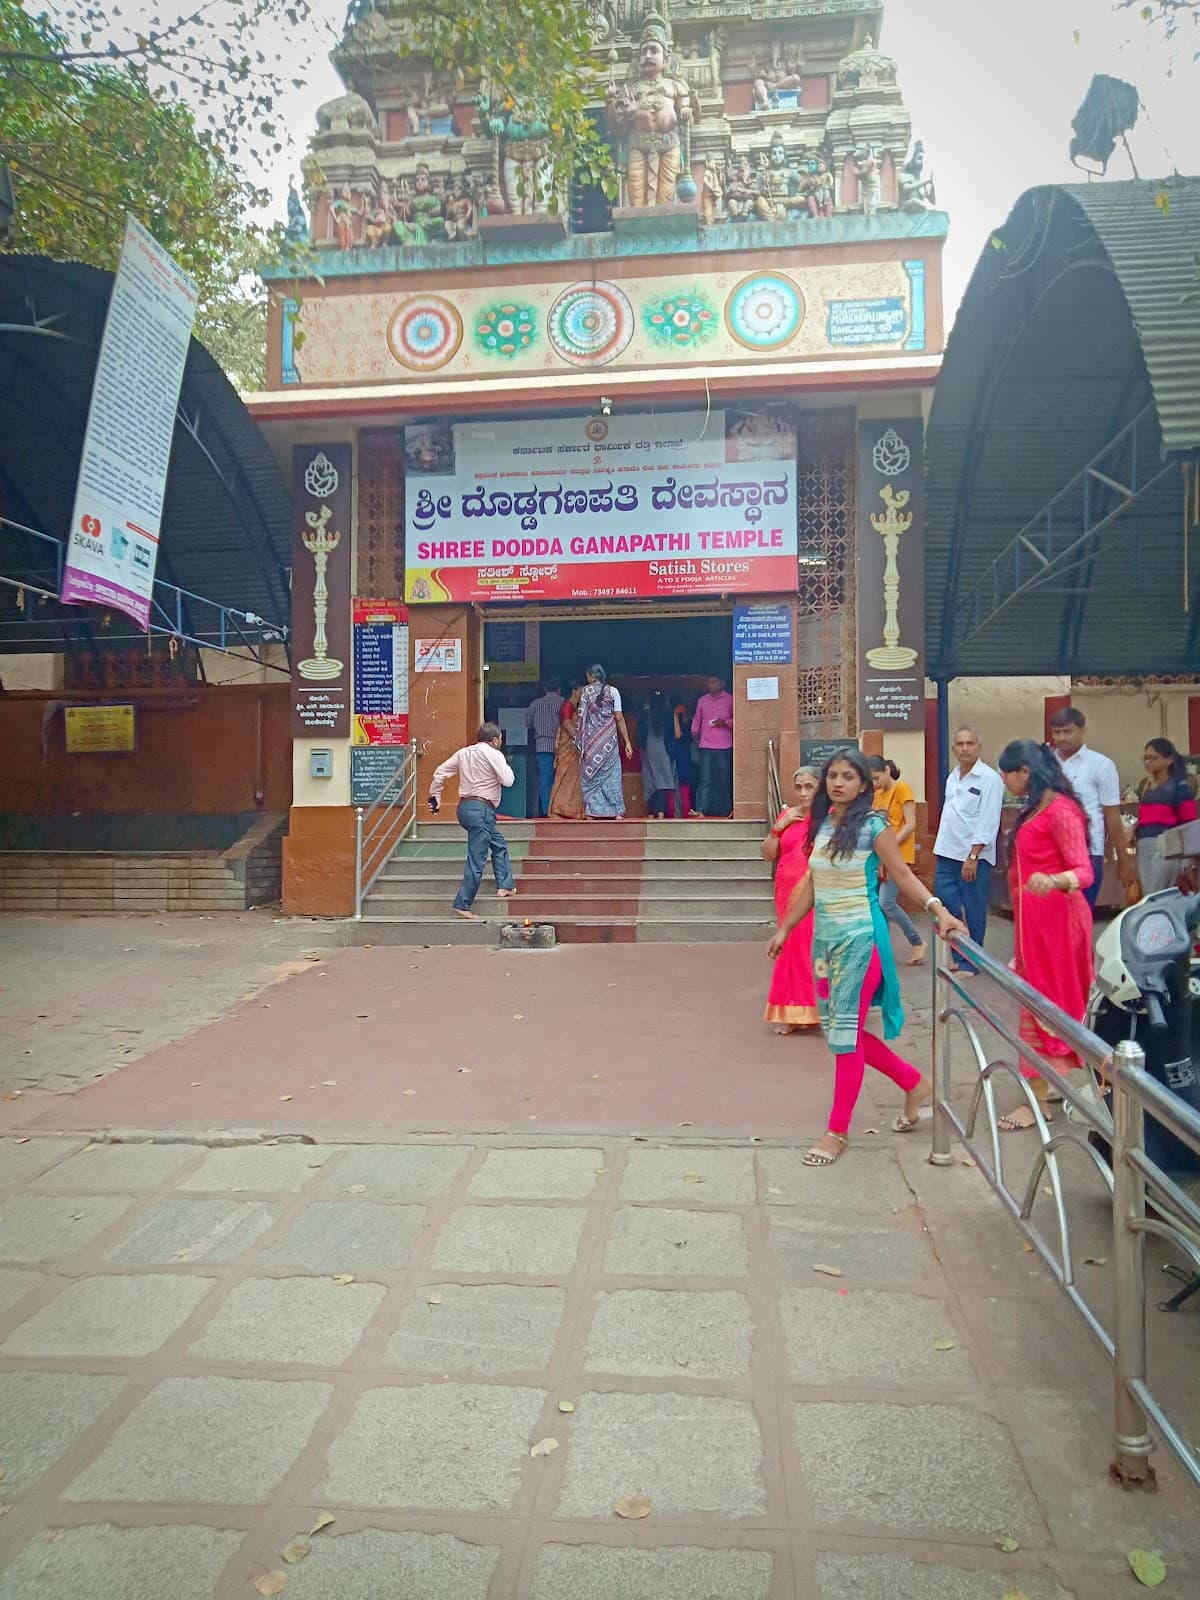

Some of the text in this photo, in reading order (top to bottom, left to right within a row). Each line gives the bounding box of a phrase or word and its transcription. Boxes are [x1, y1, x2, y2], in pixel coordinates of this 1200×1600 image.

[412, 472, 789, 530] ಶ್ರೀ ದೊಡ್ಡಗಣಪತಿ ದೇವಸ್ಥಾನ
[73, 533, 104, 557] SKAVA
[417, 528, 783, 560] SHREE DODDA GANAPATHI TEMPLE
[477, 567, 514, 578] ಸತೀಶ್
[649, 558, 750, 576] Satish Stores
